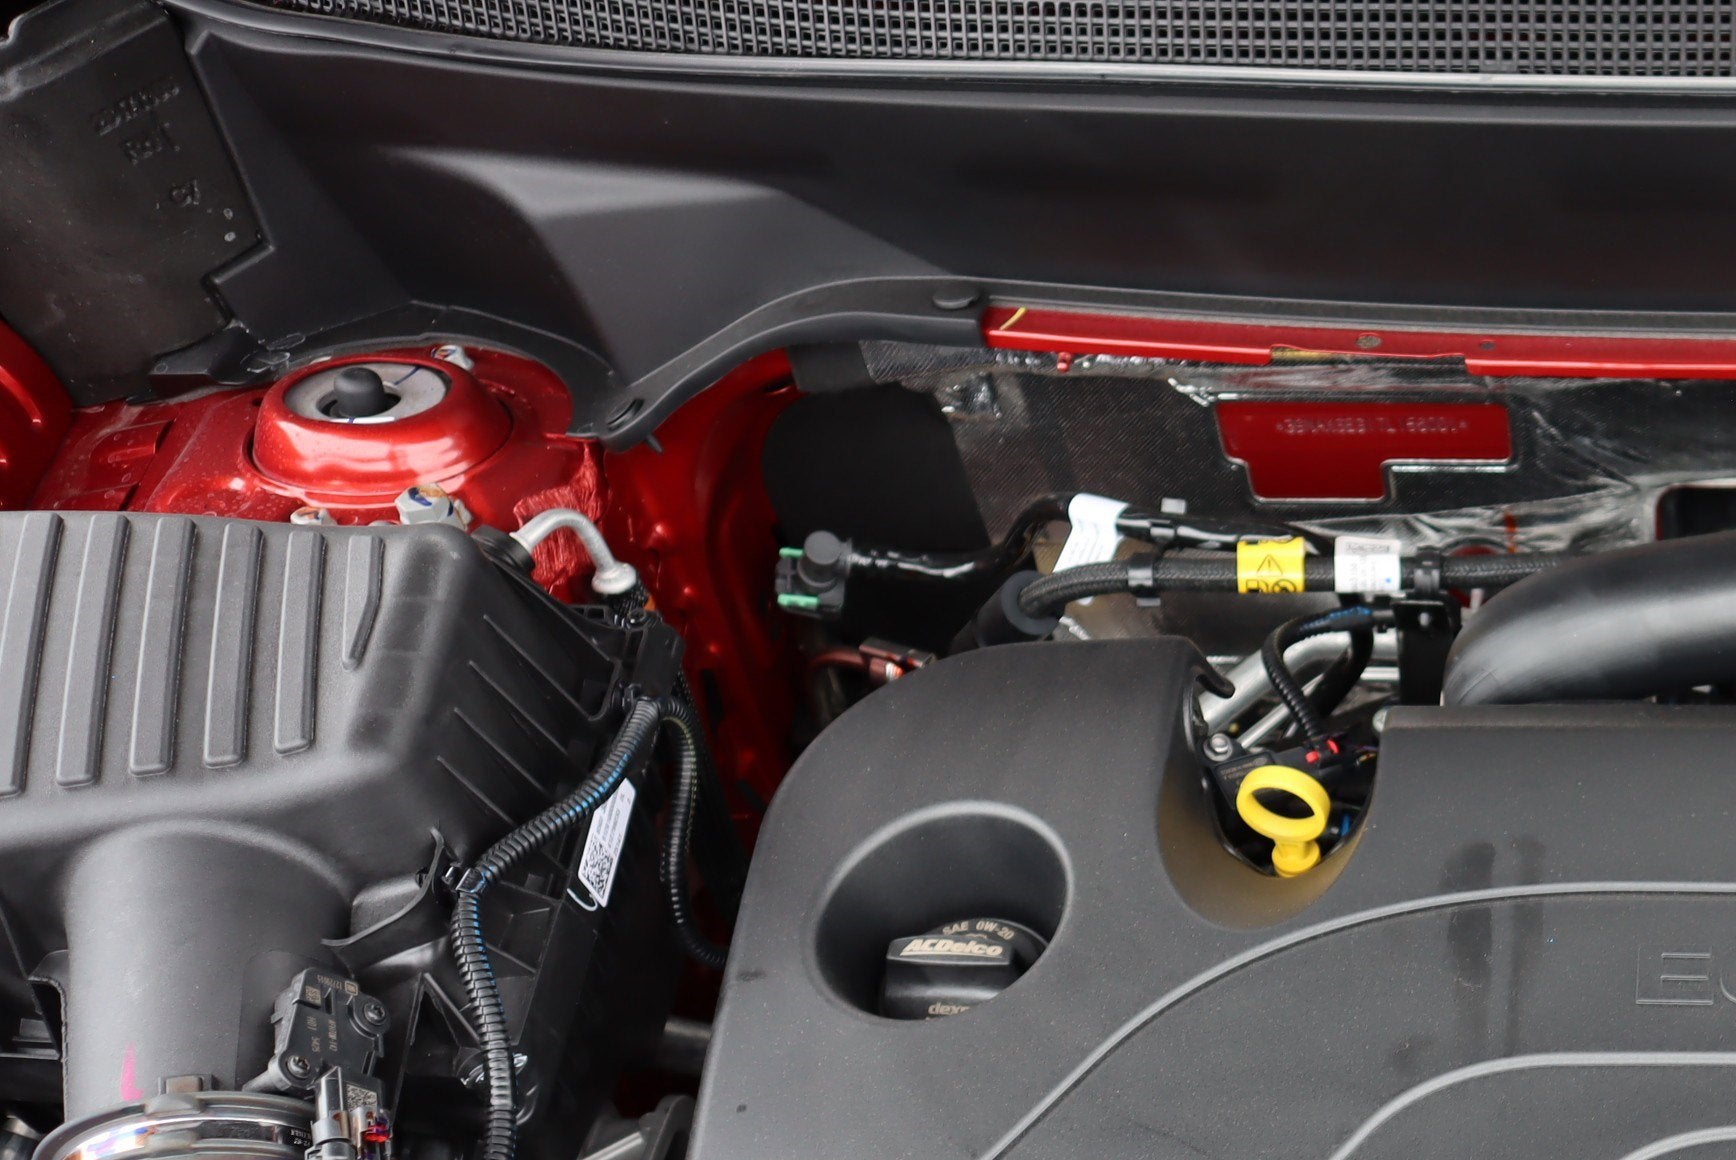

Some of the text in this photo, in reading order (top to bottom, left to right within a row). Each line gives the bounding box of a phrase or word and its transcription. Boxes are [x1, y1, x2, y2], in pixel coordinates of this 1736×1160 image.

[942, 920, 1015, 941] SAE 0W-20
[900, 938, 1004, 957] ACDelco
